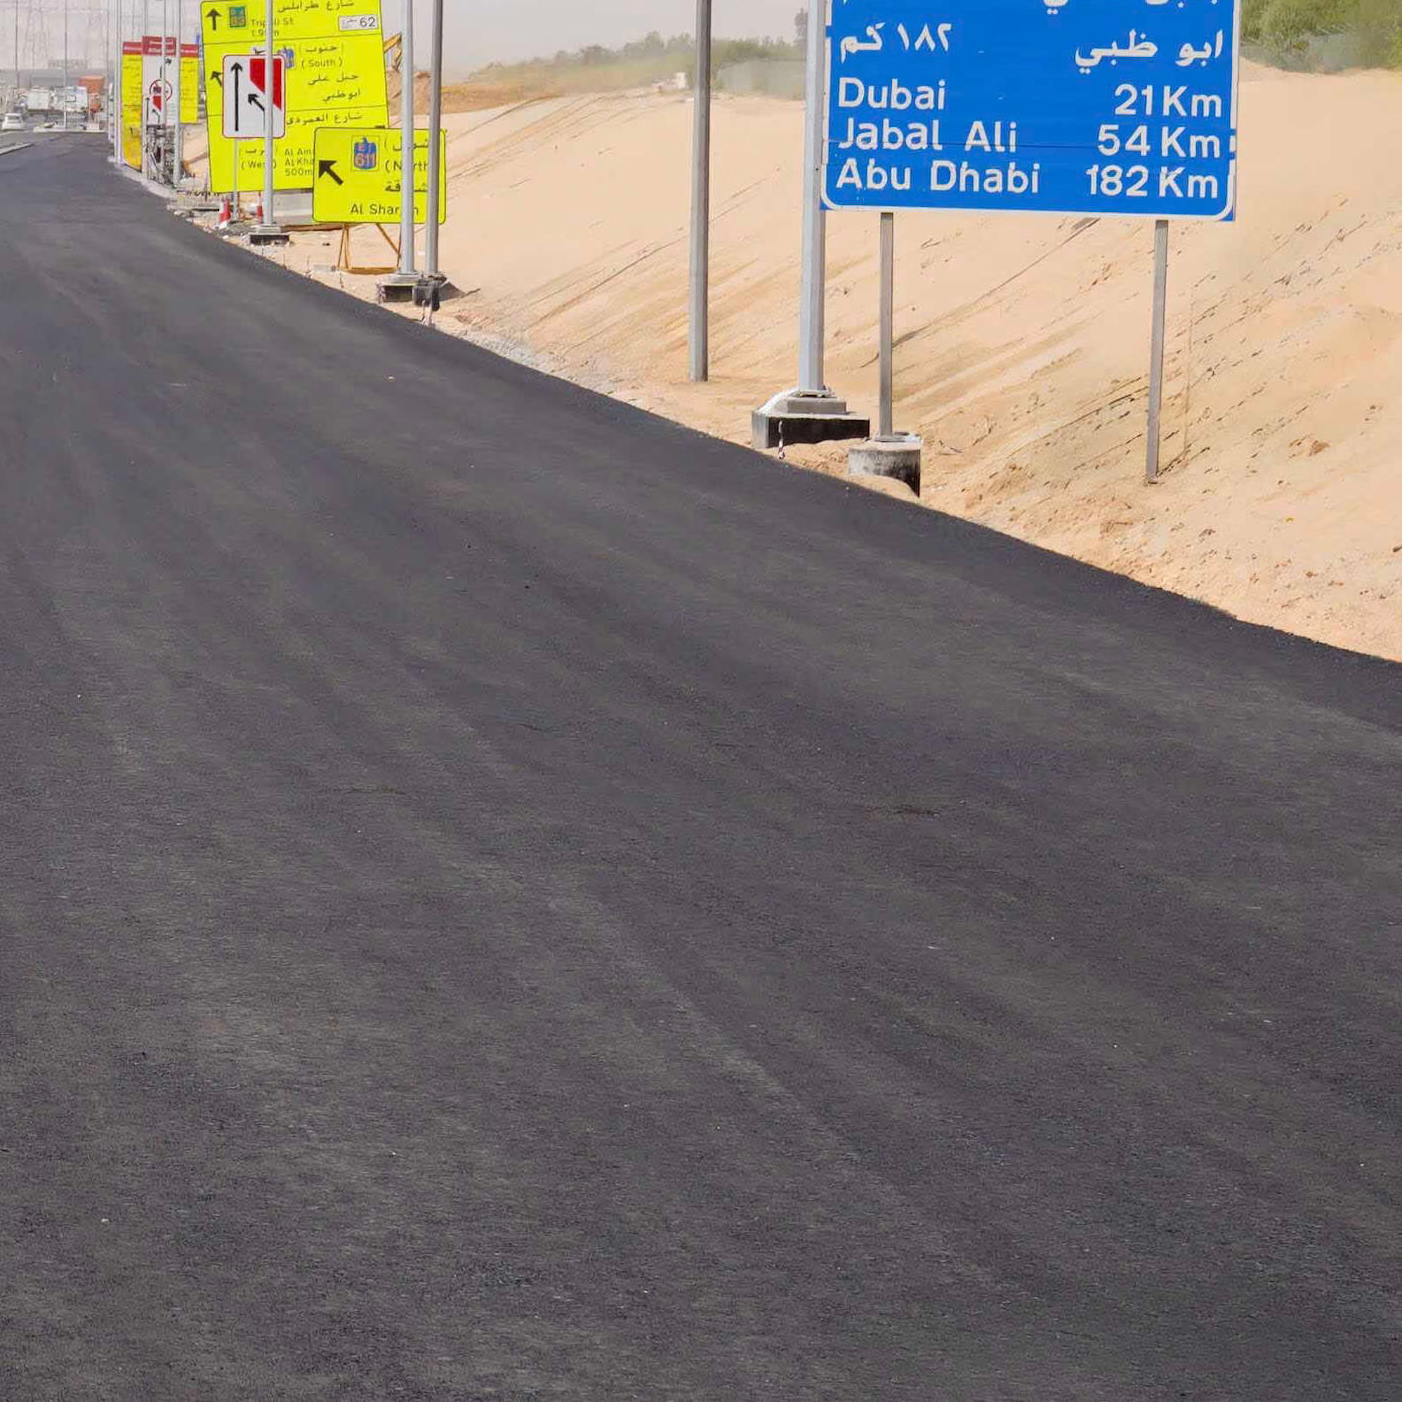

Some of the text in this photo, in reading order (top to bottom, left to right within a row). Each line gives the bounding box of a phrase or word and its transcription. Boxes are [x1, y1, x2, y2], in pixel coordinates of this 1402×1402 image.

[250, 18, 282, 29] Tripli
[359, 16, 377, 28] 62
[898, 24, 951, 50] ١٨٢
[841, 23, 884, 62] كم
[1076, 30, 1157, 74] ظبي
[839, 77, 1221, 117] Dubai 21 Km
[839, 118, 1220, 158] Jabal Ali 54 Km
[836, 158, 1218, 198] Abu Dhabi 182 Km
[350, 203, 364, 214] Al
